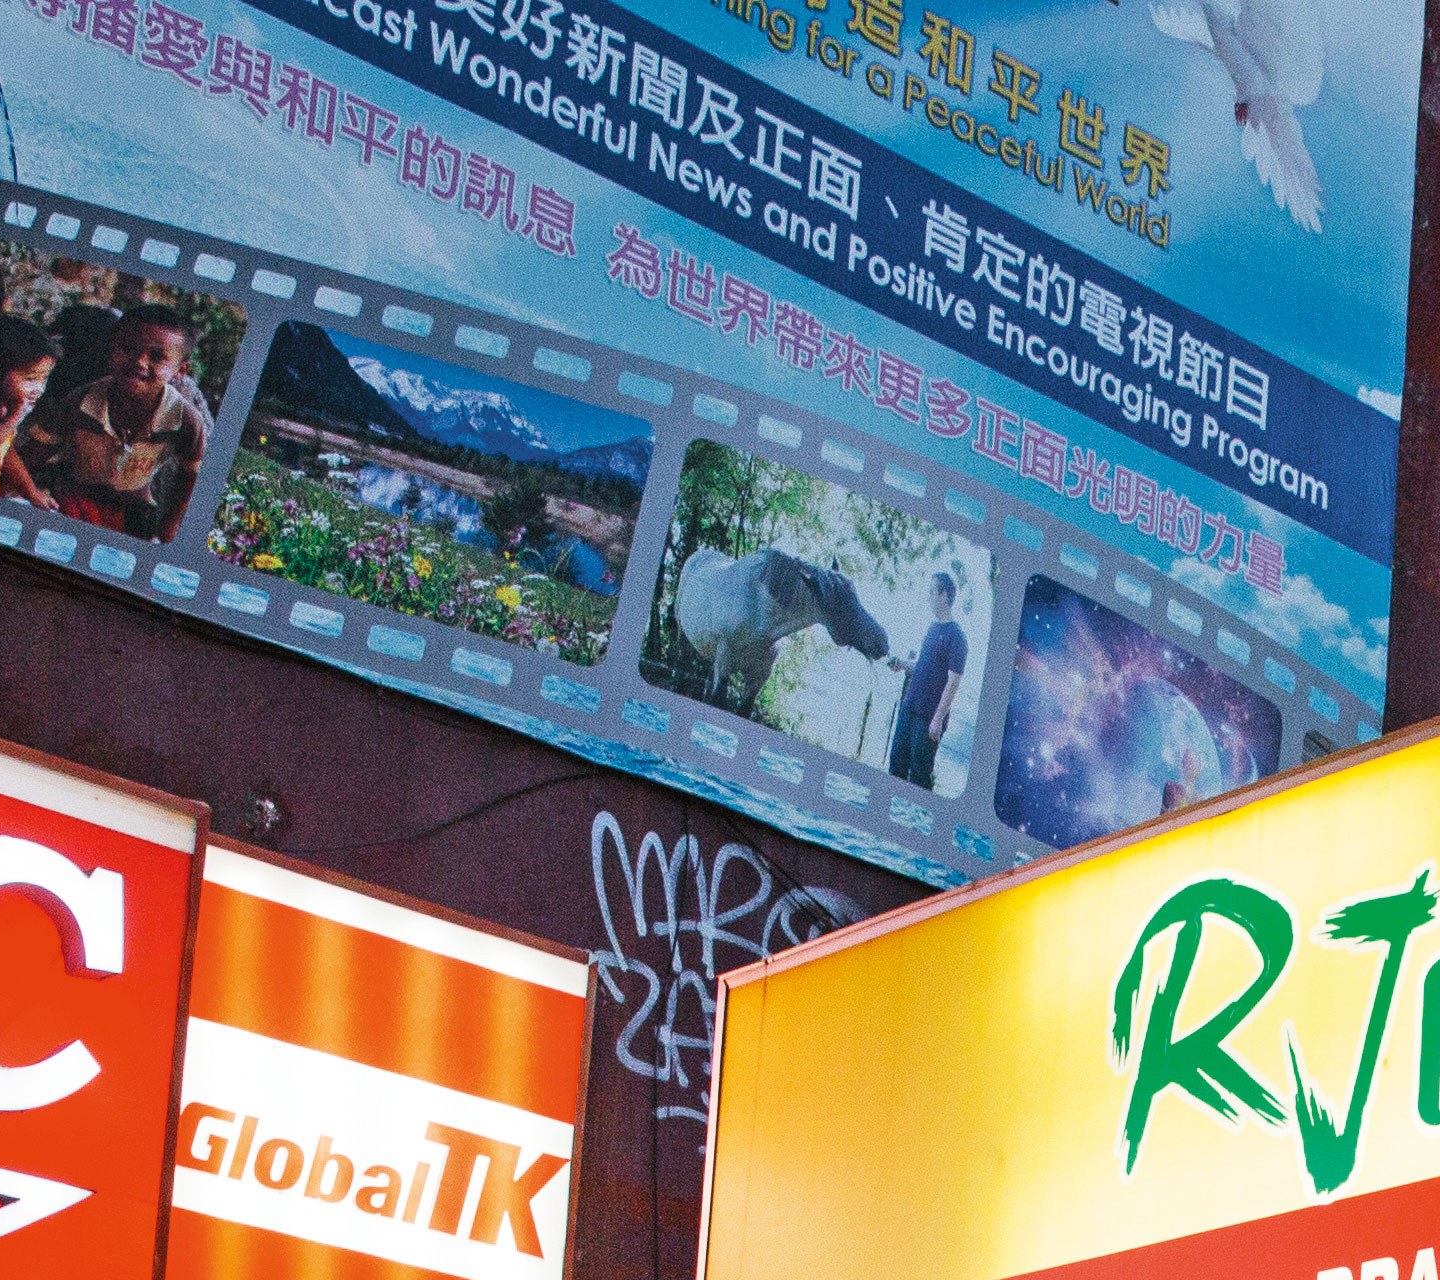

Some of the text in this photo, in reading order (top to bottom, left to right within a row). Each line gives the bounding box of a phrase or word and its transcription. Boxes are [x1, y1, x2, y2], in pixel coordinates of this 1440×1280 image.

[800, 0, 1173, 198] 造和平世界
[807, 25, 1171, 249] for a Peaceful World
[430, 18, 1329, 510] Wonderful News and Positive Encouraging Program
[174, 1099, 571, 1261] GlobalTK
